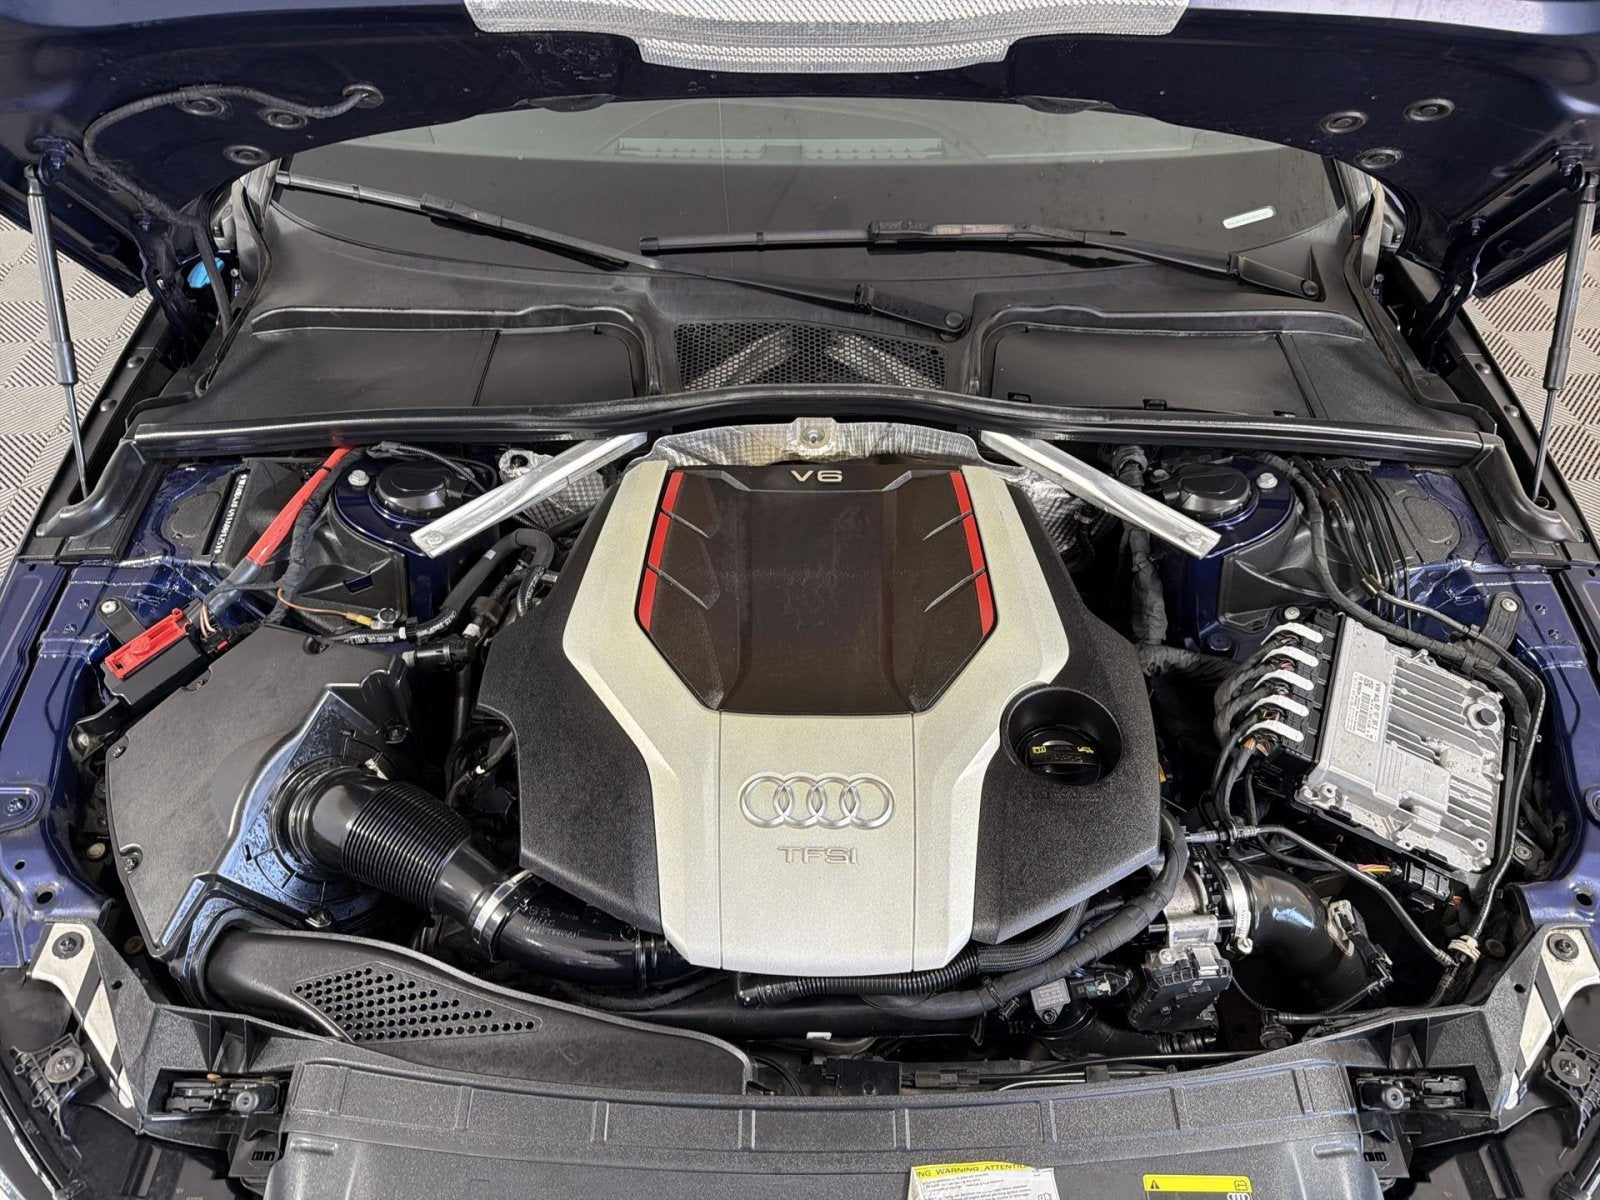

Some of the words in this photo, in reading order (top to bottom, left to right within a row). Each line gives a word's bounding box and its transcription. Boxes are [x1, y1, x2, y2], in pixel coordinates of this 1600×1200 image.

[790, 470, 842, 483] V6
[777, 846, 858, 864] TFSI
[936, 1166, 979, 1176] WARNING
